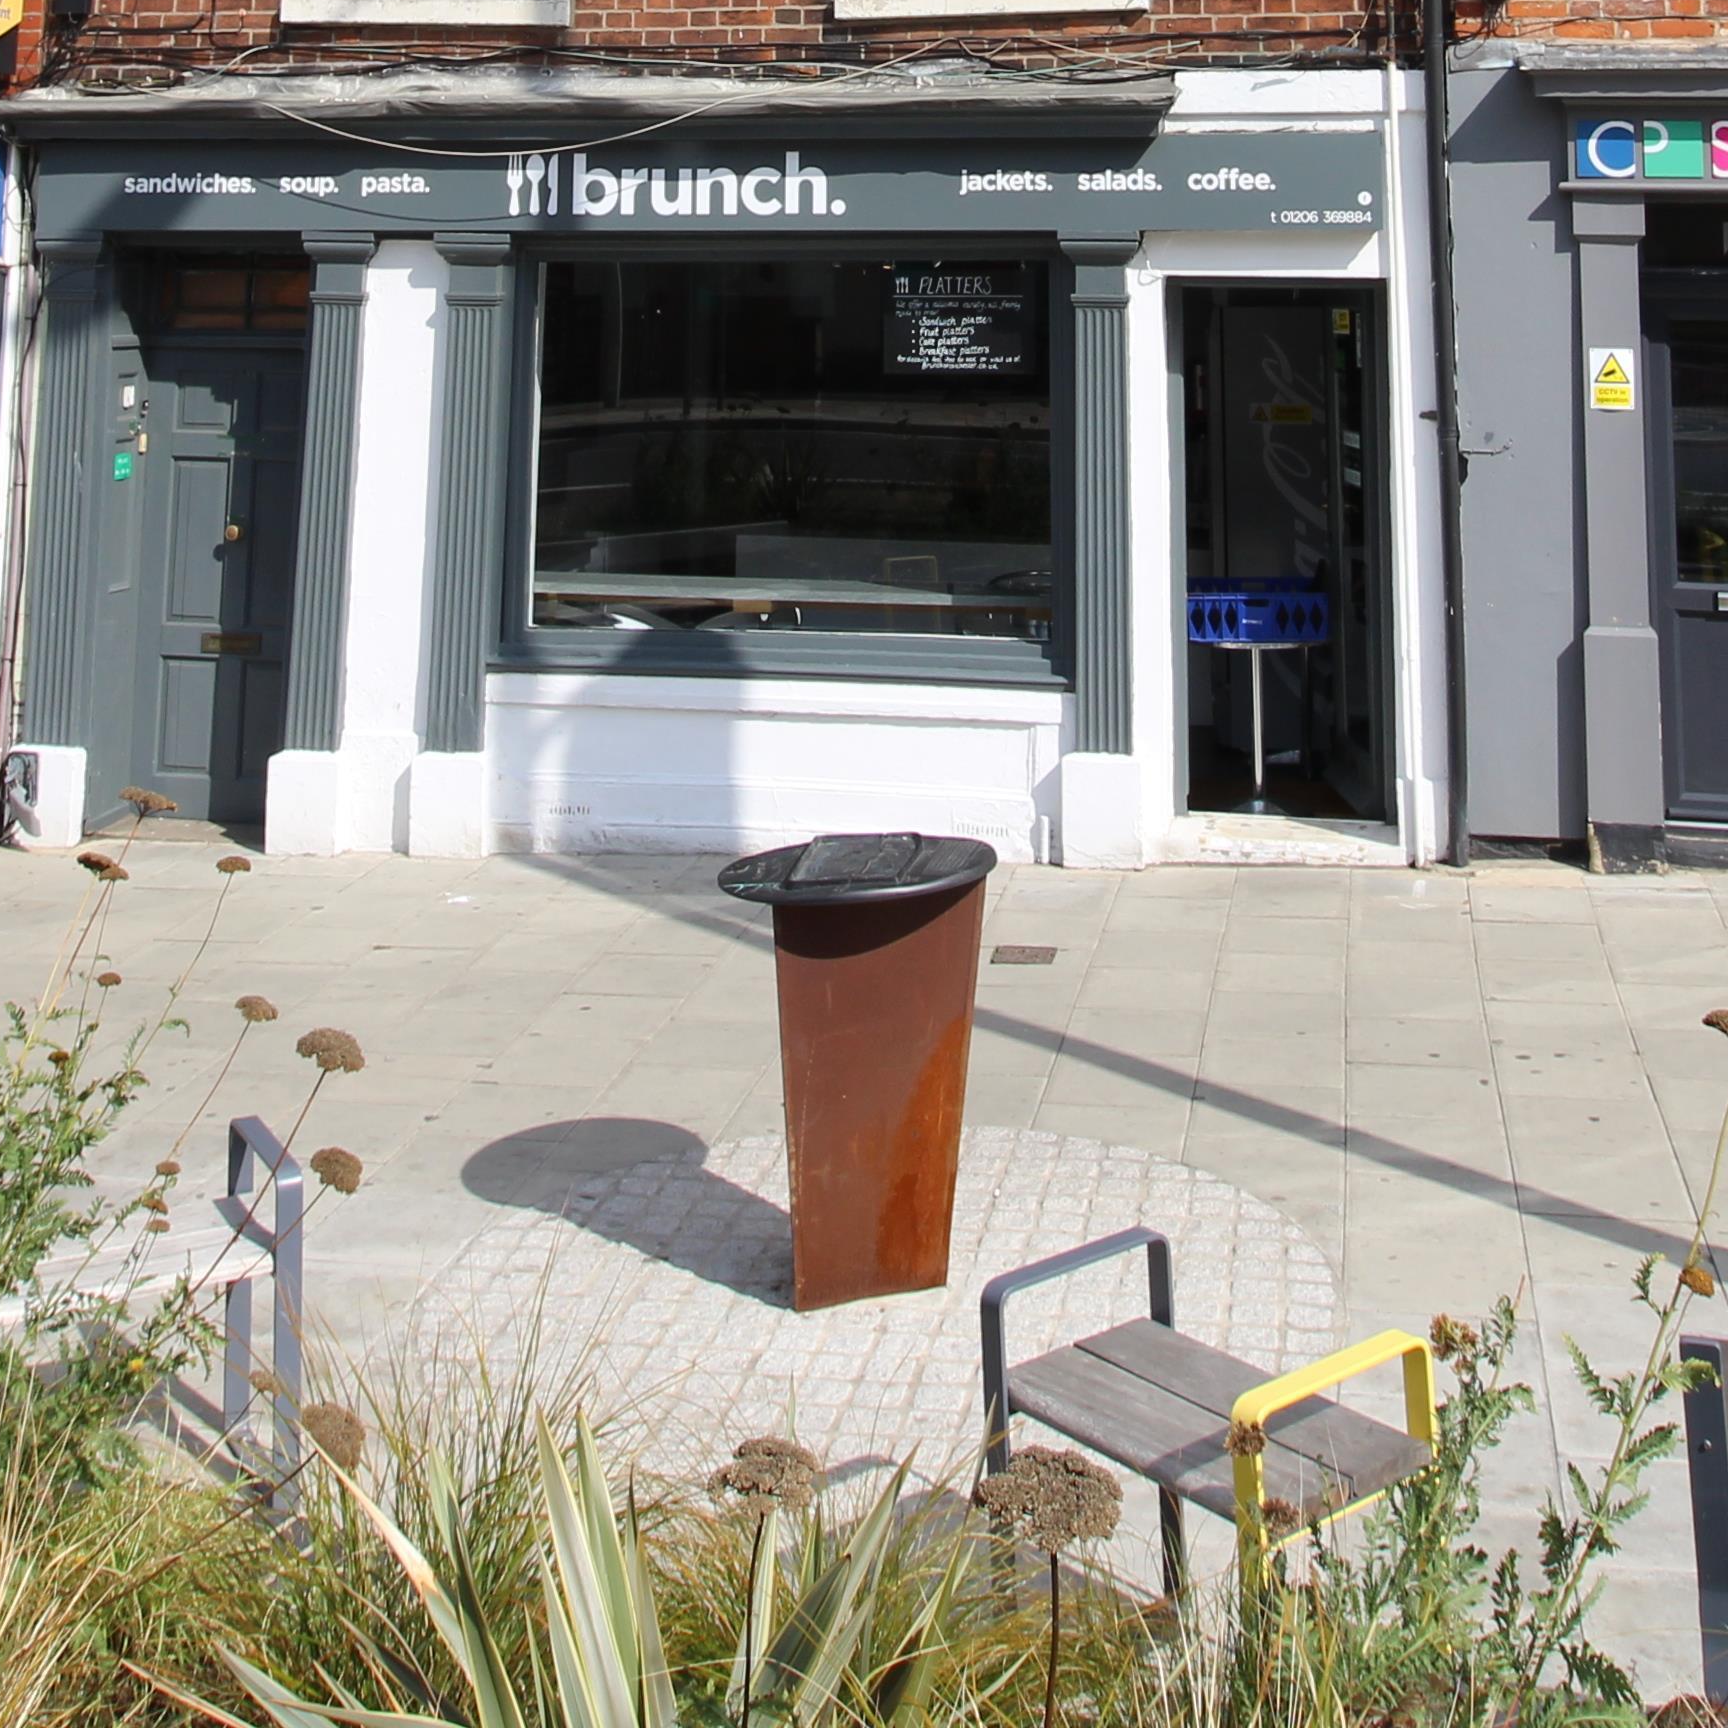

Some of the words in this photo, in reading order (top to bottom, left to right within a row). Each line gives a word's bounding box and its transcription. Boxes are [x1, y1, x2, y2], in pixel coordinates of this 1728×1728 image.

[124, 173, 257, 194] sandwiches.
[279, 175, 339, 197] soup.
[361, 173, 430, 197] pasta.
[572, 151, 847, 216] brunch.
[959, 168, 1053, 196] jackets.
[1077, 168, 1163, 192] salads.
[1186, 167, 1277, 192] coffee.
[1280, 210, 1319, 224] 01206
[918, 276, 992, 295] PLATTERS
